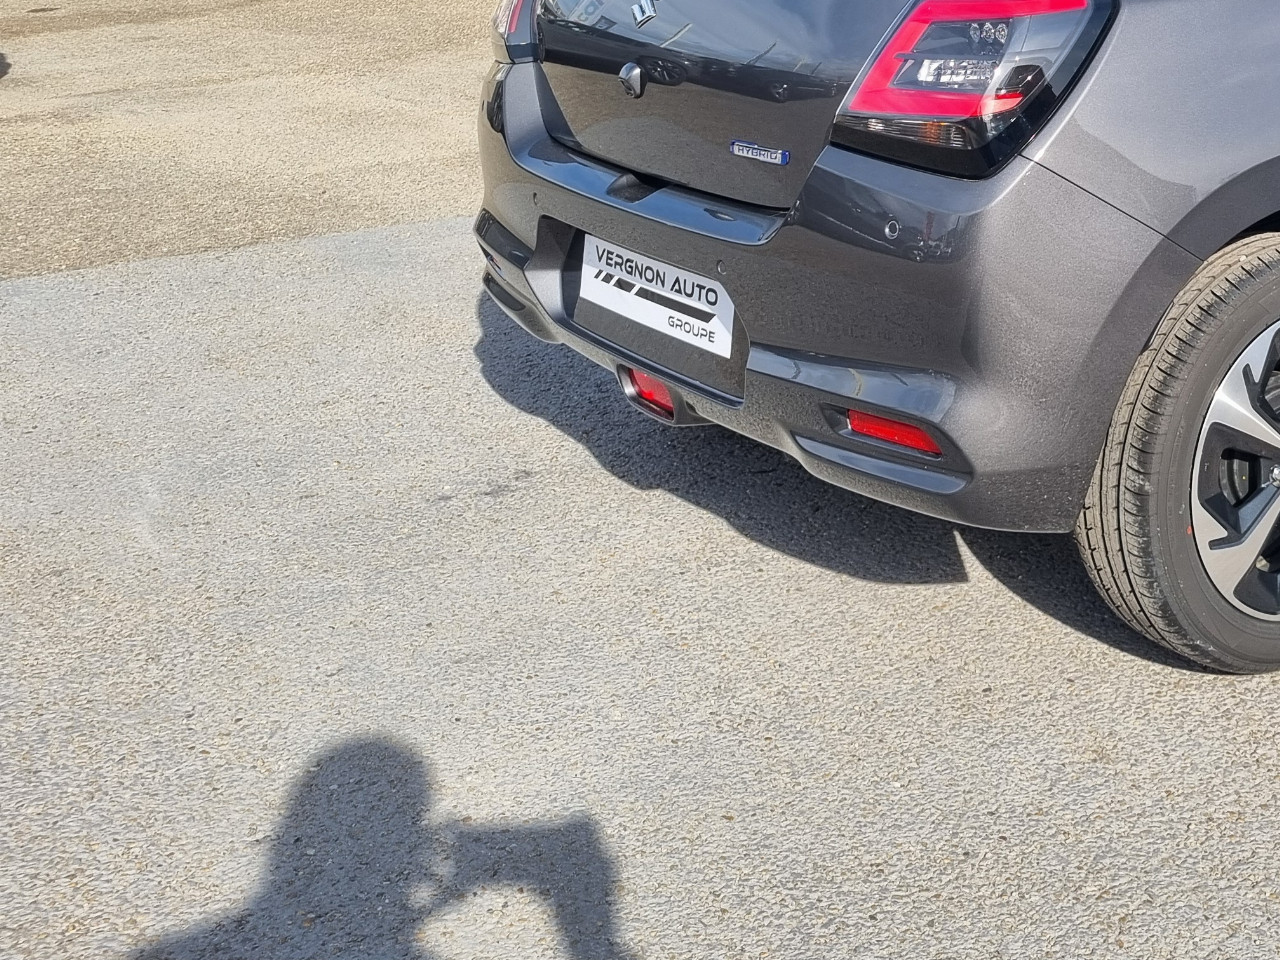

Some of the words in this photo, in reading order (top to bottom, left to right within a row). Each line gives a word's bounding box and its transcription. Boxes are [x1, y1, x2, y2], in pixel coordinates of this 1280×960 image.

[737, 146, 778, 160] HYBRID
[594, 245, 667, 291] VERGNON
[670, 276, 719, 307] AUTO
[668, 316, 716, 343] GROUPE
